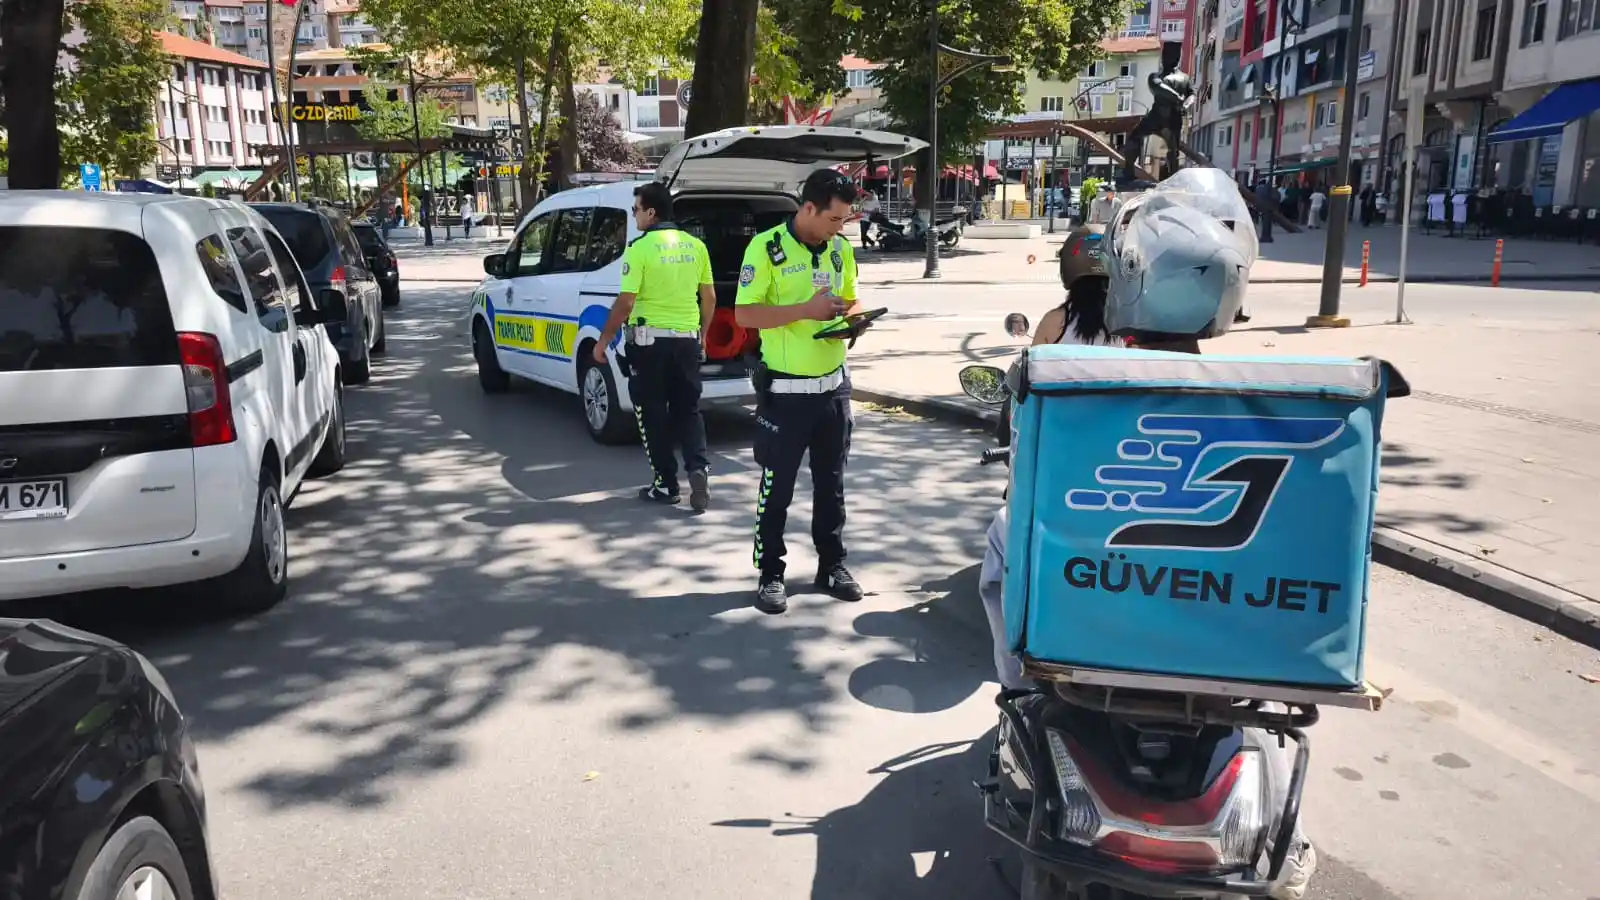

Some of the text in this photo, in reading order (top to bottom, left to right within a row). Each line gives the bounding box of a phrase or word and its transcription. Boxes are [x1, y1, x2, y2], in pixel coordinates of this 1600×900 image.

[20, 482, 61, 508] 671
[1064, 552, 1342, 614] GÜVEN JET
